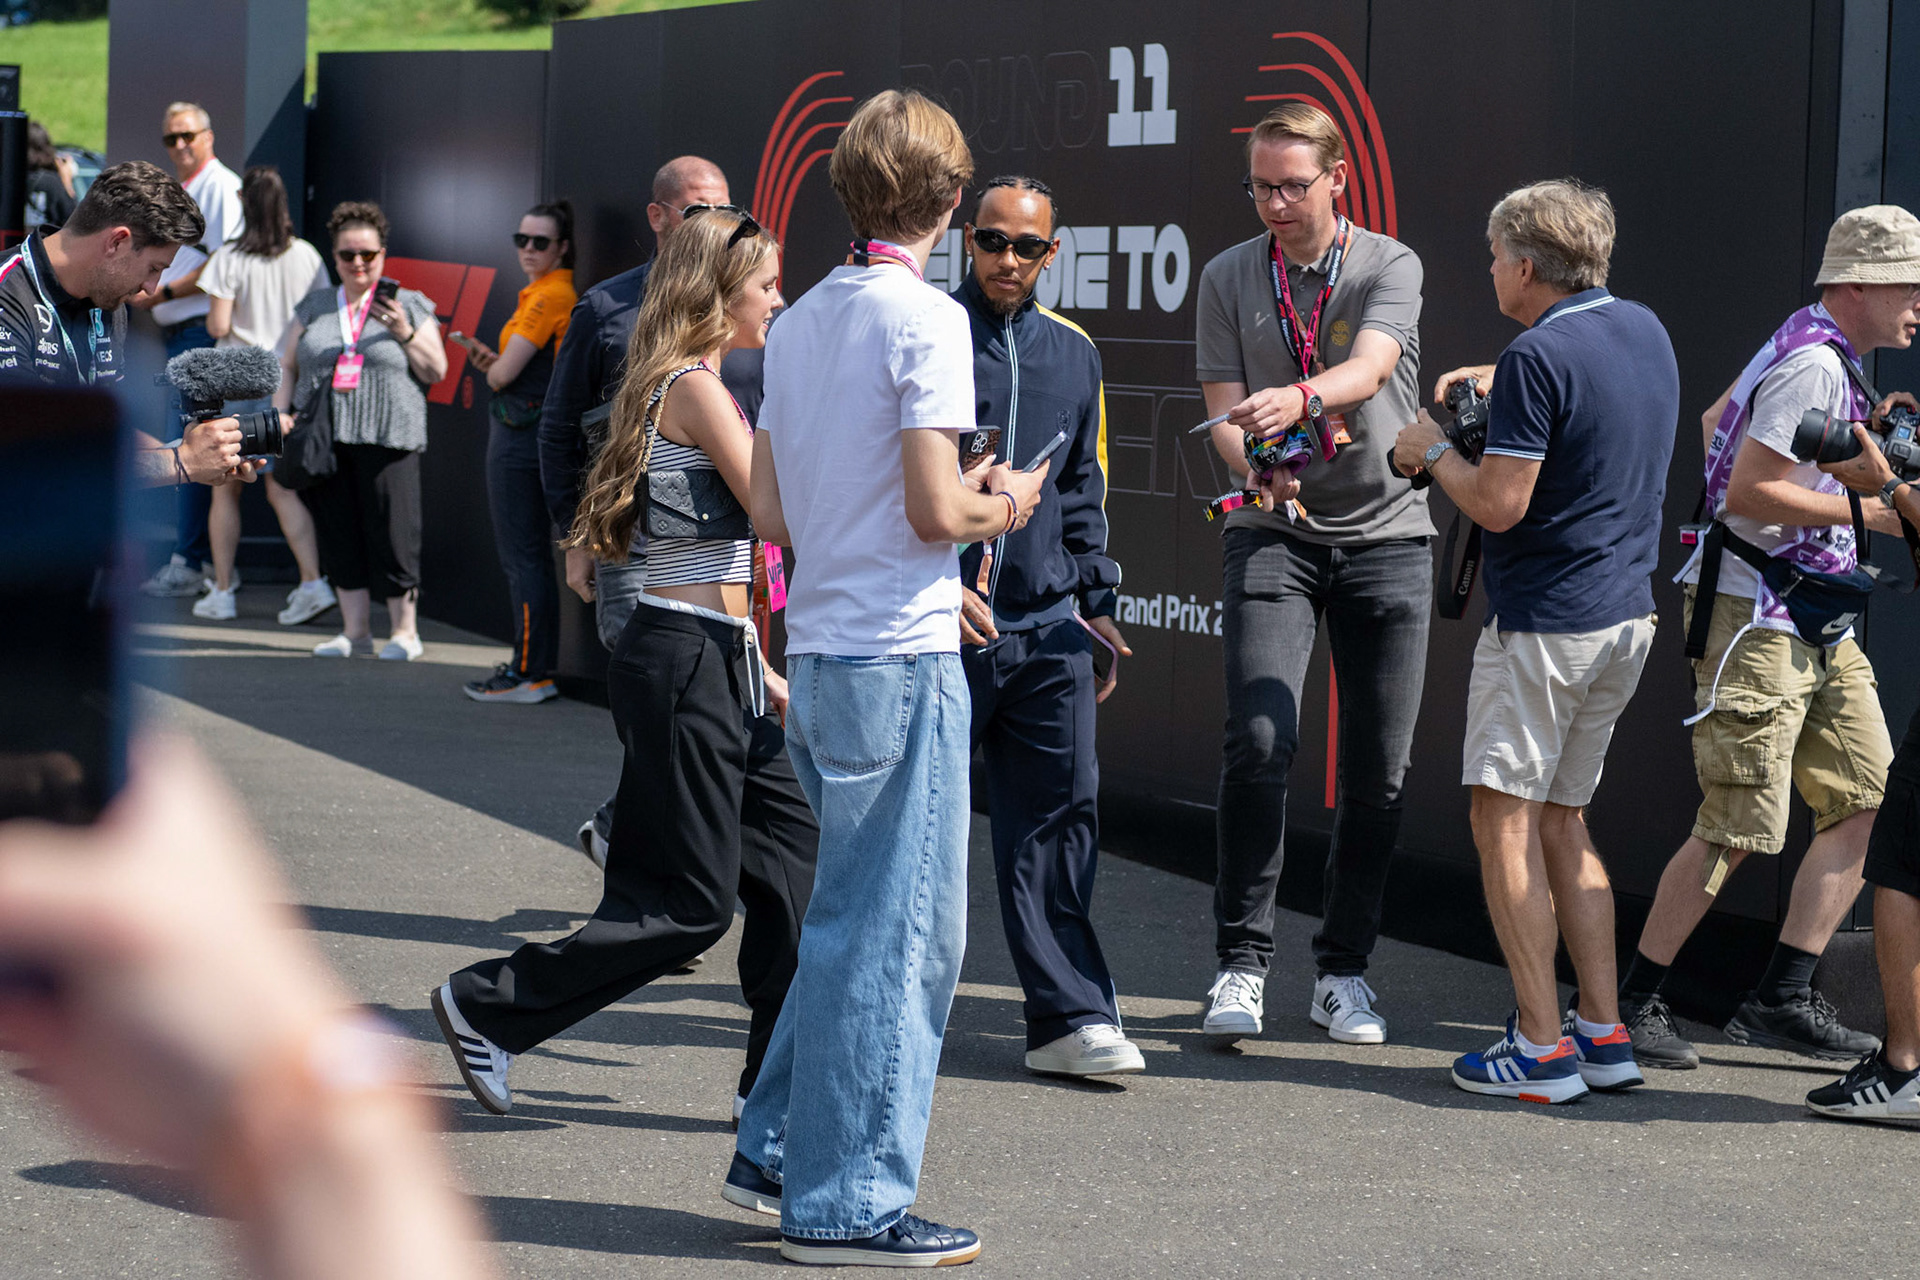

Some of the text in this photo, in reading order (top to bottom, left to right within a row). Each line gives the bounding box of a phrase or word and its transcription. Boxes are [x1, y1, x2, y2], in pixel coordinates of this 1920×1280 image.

[1107, 43, 1177, 147] 11
[1117, 223, 1190, 313] TO
[1211, 490, 1244, 507] PETRONAS
[768, 562, 783, 584] VIP
[1458, 560, 1475, 595] Canon
[1115, 593, 1163, 628] rand
[1165, 594, 1210, 635] Prix
